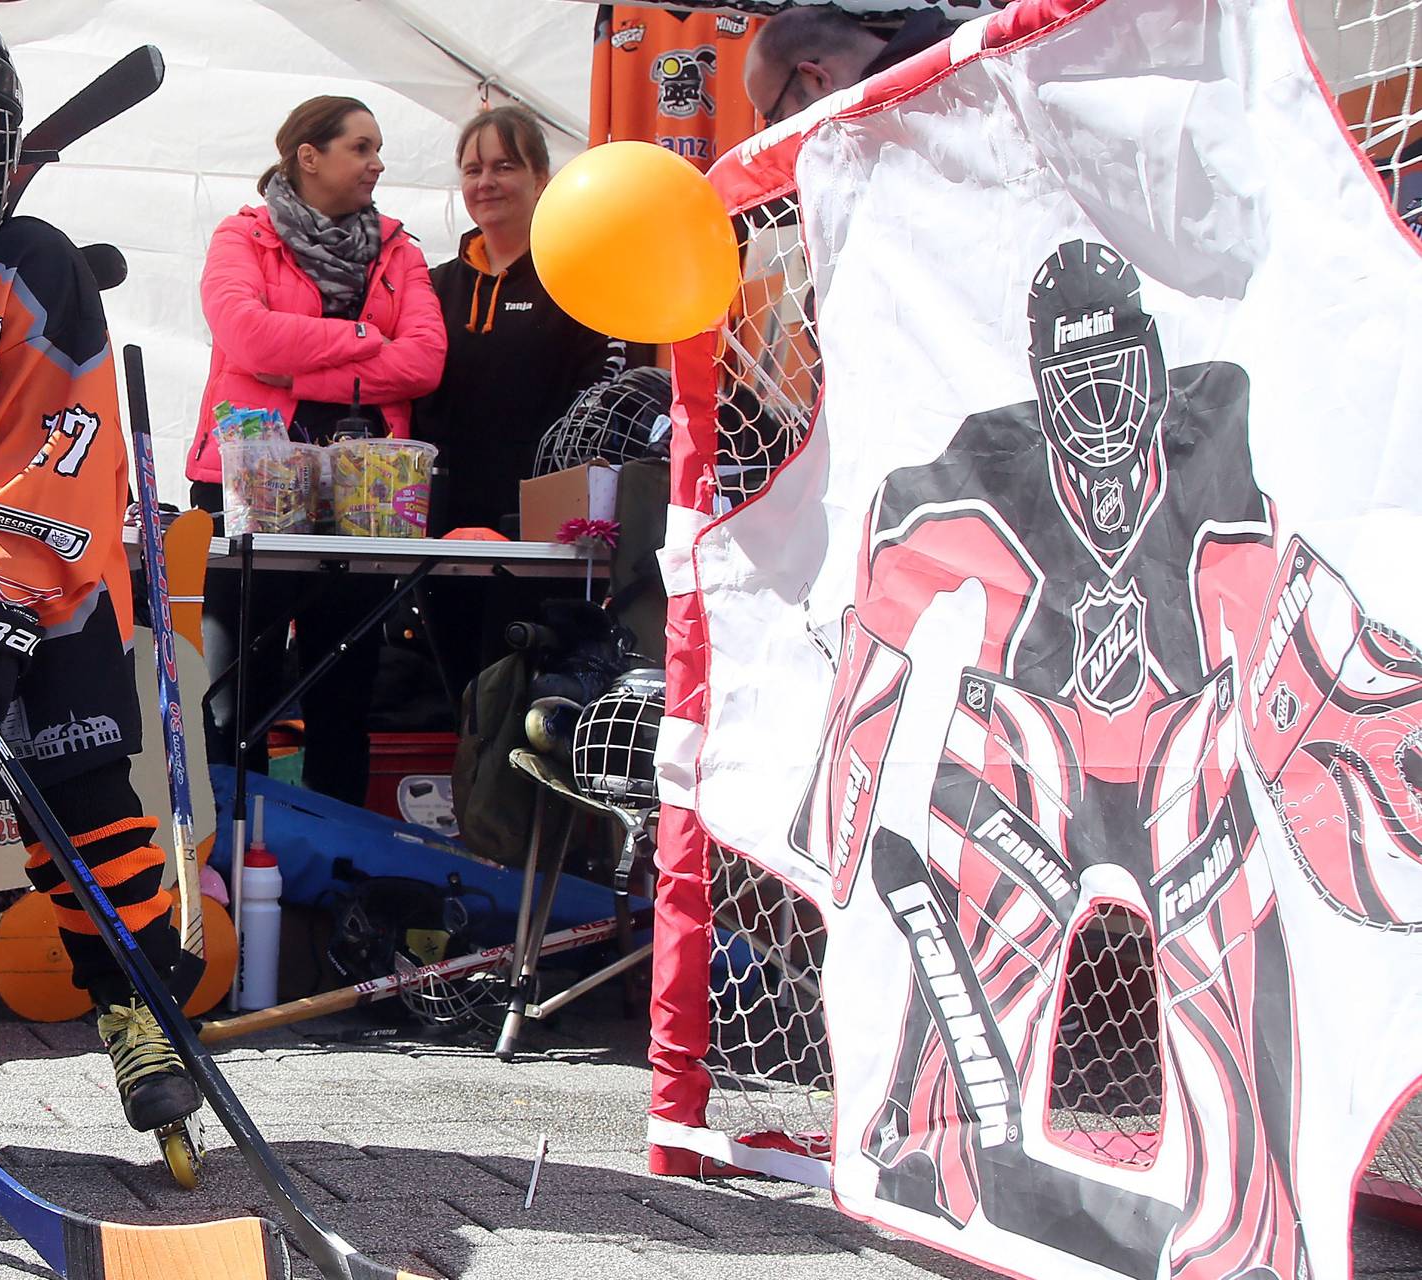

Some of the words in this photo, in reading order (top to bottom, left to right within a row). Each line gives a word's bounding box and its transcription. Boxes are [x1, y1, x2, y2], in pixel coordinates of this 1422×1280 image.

[504, 301, 533, 311] Tanja
[1054, 308, 1115, 354] Franklin
[1099, 491, 1119, 523] NHL
[1090, 615, 1135, 691] NHL
[972, 808, 1071, 901] Franklin
[1158, 833, 1234, 934] Franklin
[886, 880, 1010, 1150] Franklin
